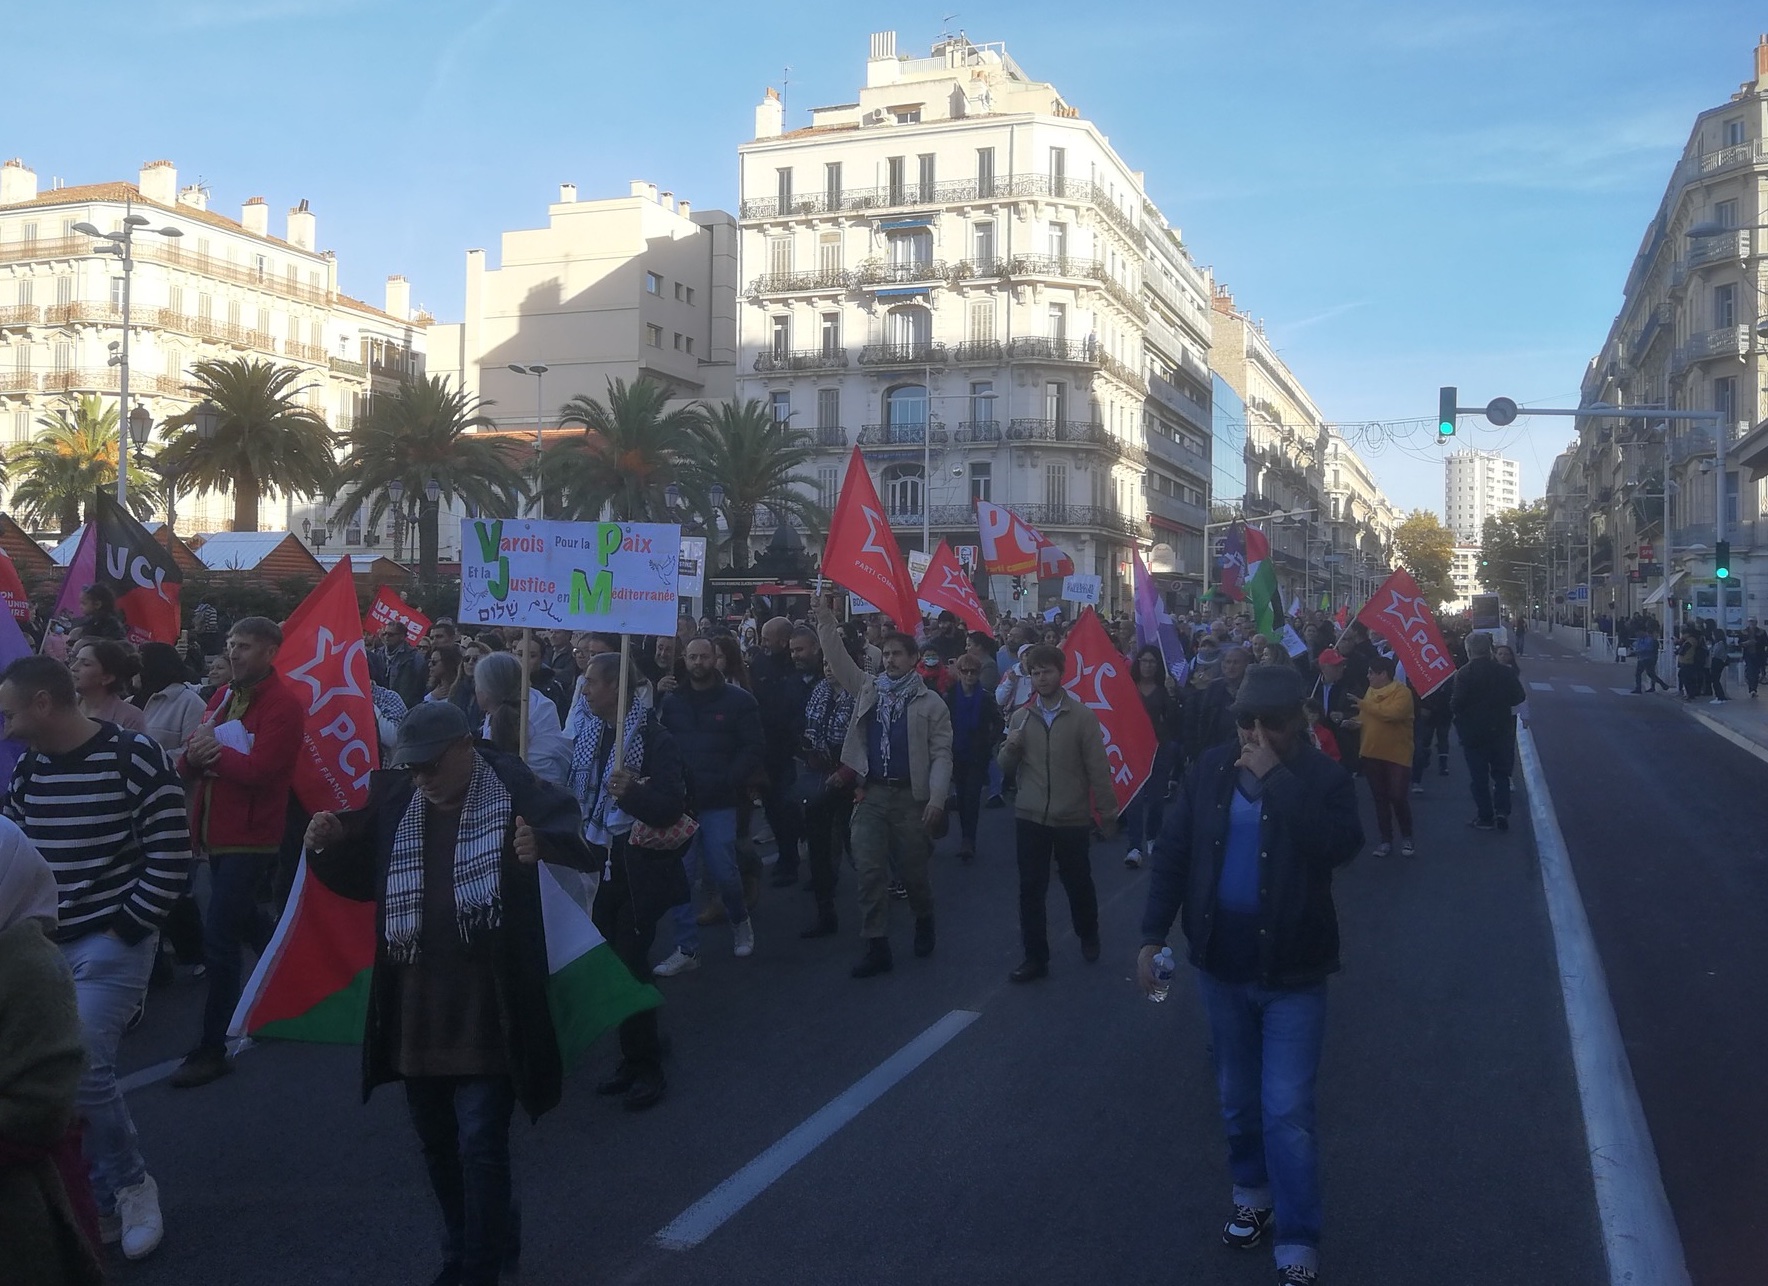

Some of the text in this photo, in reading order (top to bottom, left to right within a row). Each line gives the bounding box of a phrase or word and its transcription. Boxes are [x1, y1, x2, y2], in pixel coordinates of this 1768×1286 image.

[474, 520, 653, 567] Varois Pour la Paix
[468, 556, 556, 602] Et la Justice
[854, 560, 876, 576] PARTI
[557, 569, 675, 615] en Méditerranée
[968, 597, 992, 626] PC
[1411, 629, 1449, 671] PCF
[303, 732, 322, 764] NISTE
